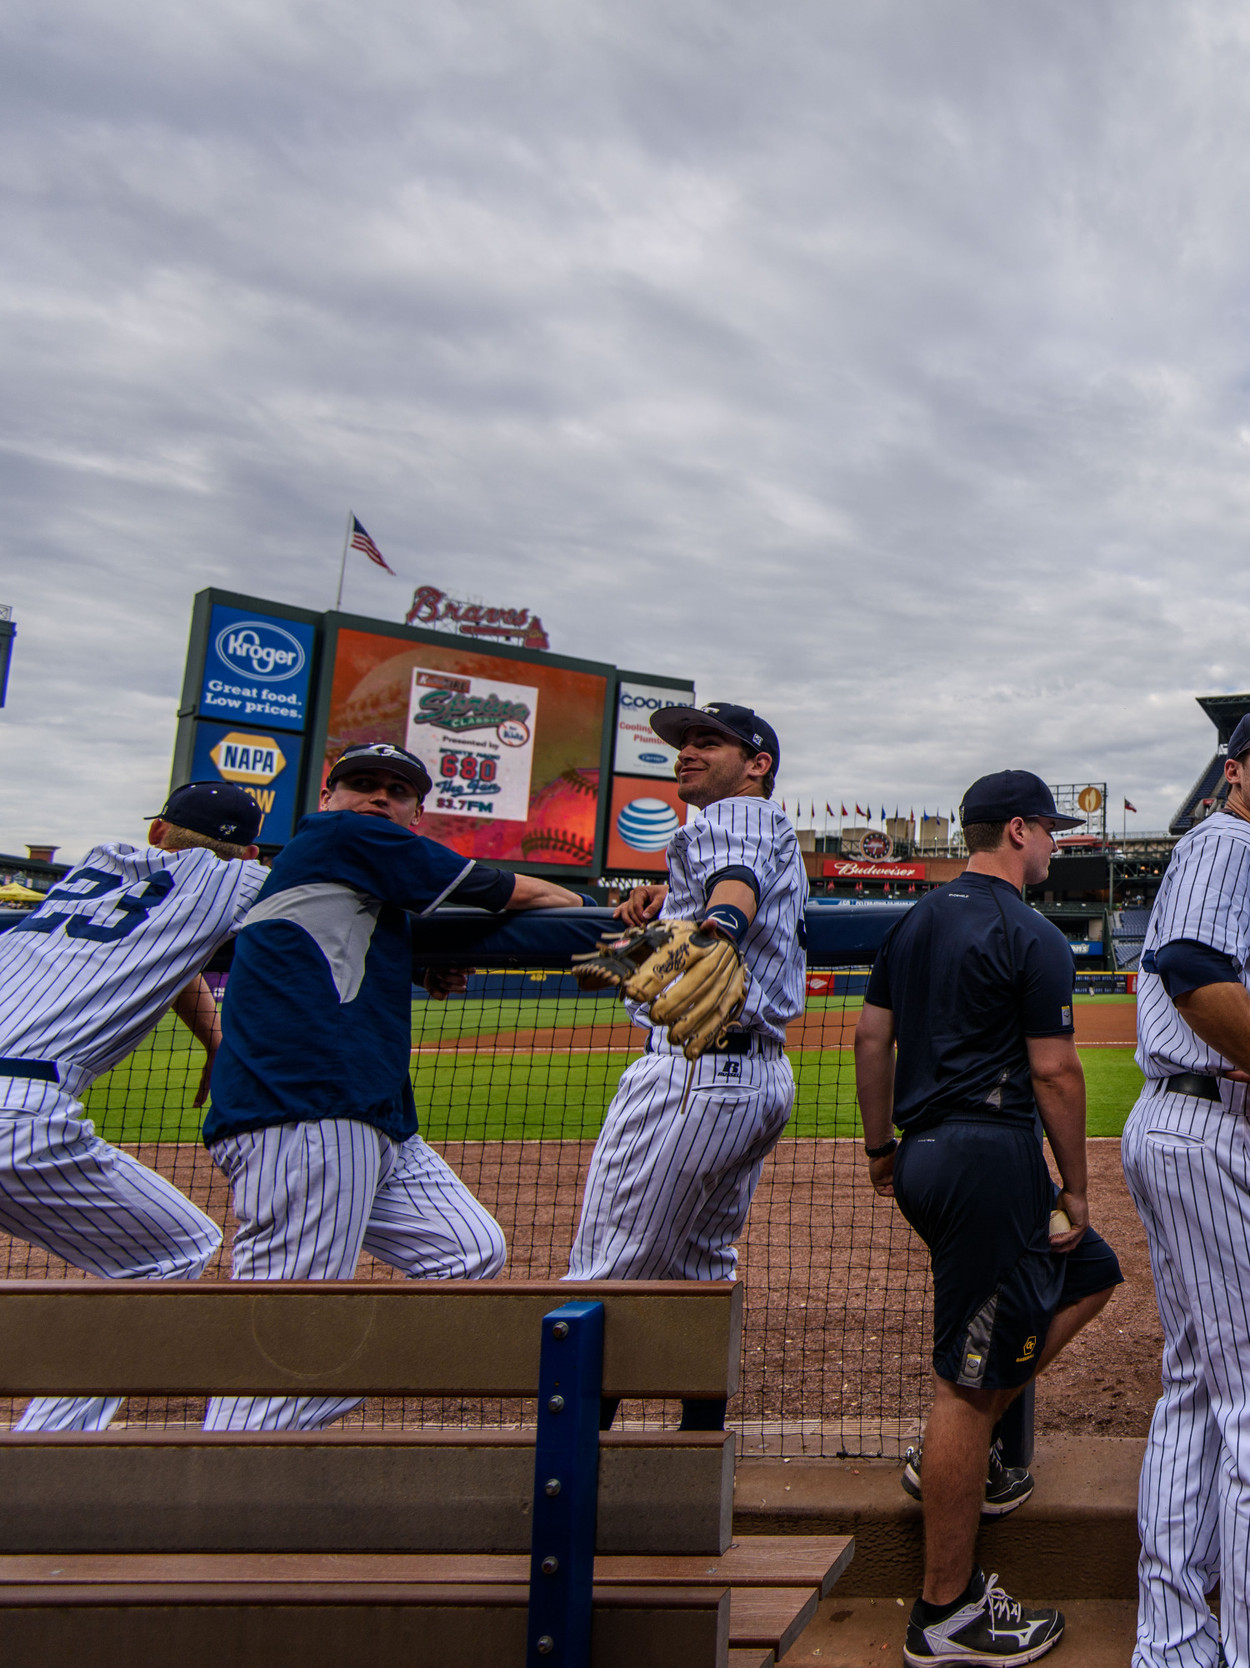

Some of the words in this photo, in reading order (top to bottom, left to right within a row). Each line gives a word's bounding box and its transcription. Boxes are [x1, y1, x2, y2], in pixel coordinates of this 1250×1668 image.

[406, 586, 530, 626] Braves
[227, 630, 297, 673] Kroger
[204, 692, 242, 709] Low
[244, 702, 302, 719] prices.
[208, 680, 258, 698] Great
[261, 689, 302, 706] food.
[619, 721, 653, 734] Cooling
[442, 736, 487, 748] Presented
[489, 741, 499, 750] by
[224, 745, 275, 773] NAPA
[440, 754, 497, 781] 680
[834, 862, 916, 876] Budweiser
[9, 867, 175, 943] 23
